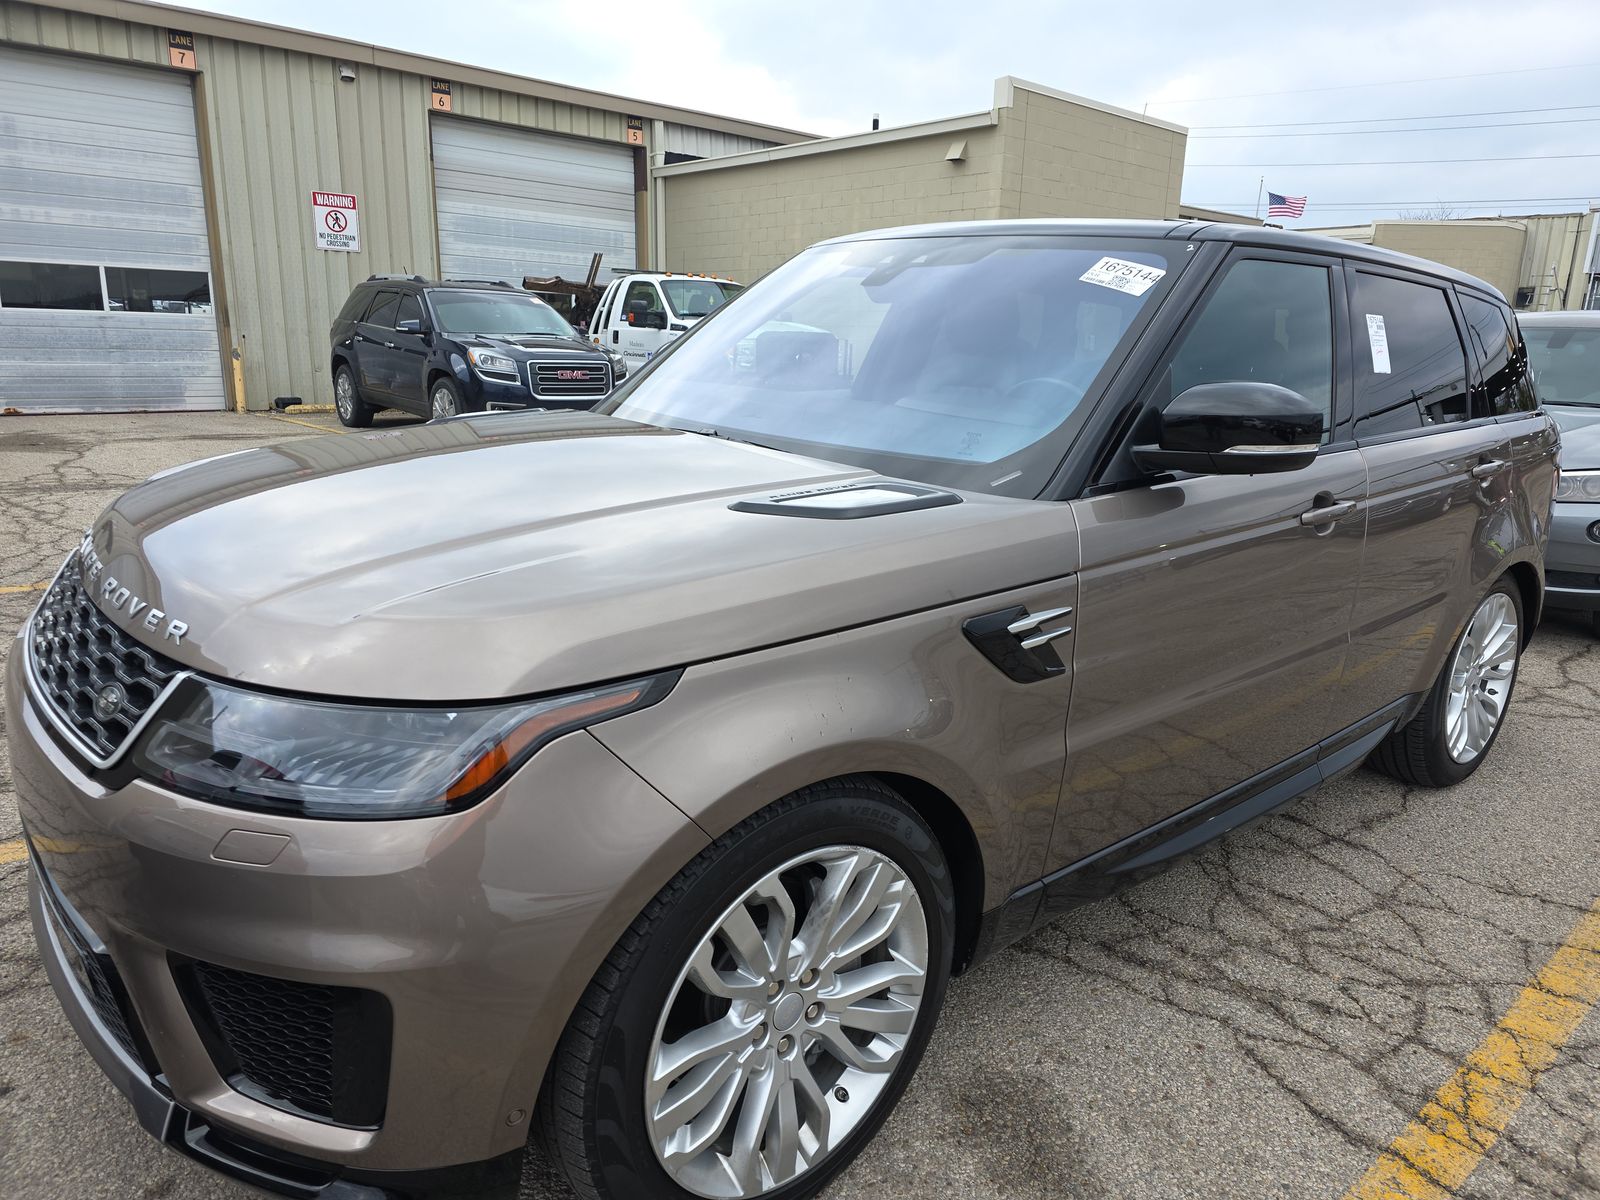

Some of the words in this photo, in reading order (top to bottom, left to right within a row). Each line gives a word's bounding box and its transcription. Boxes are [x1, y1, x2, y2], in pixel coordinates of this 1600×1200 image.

[169, 34, 193, 46] LANE
[178, 51, 186, 64] 7
[432, 81, 450, 91] LANE
[438, 96, 445, 107] 6
[632, 131, 638, 141] 5
[315, 193, 354, 208] WARNING
[327, 233, 356, 241] PEDESTRIAN
[326, 240, 350, 248] CROSSING
[1099, 260, 1161, 283] 1675144
[557, 370, 590, 380] GMC
[103, 576, 189, 645] ROVER
[850, 806, 900, 825] VERDE
